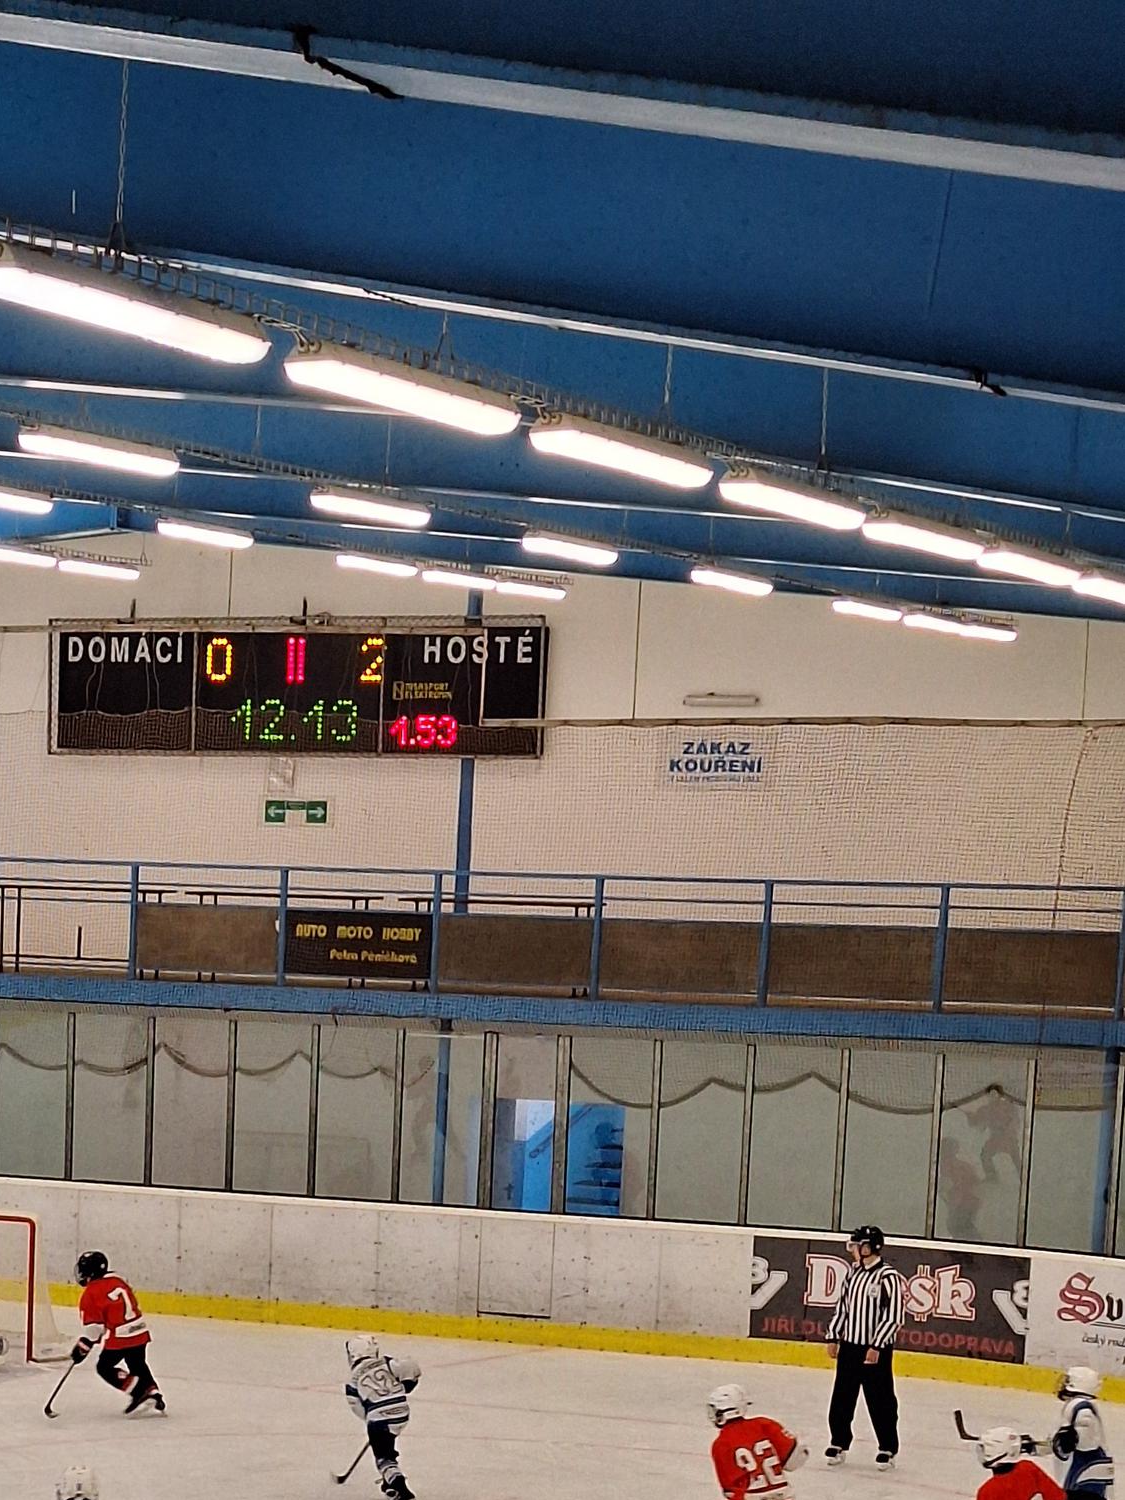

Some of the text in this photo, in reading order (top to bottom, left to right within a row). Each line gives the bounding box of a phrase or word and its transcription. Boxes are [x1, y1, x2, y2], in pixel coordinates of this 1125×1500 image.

[68, 631, 184, 663] DOMÁCÍ
[206, 637, 233, 681] 0
[423, 629, 534, 664] HOSTÉ
[360, 637, 384, 682] 2
[682, 738, 751, 755] ZÁKAZ
[669, 756, 762, 773] KOUŘENÍ
[296, 924, 422, 942] AUTO MOTO HOBBY
[330, 949, 359, 961] Petra
